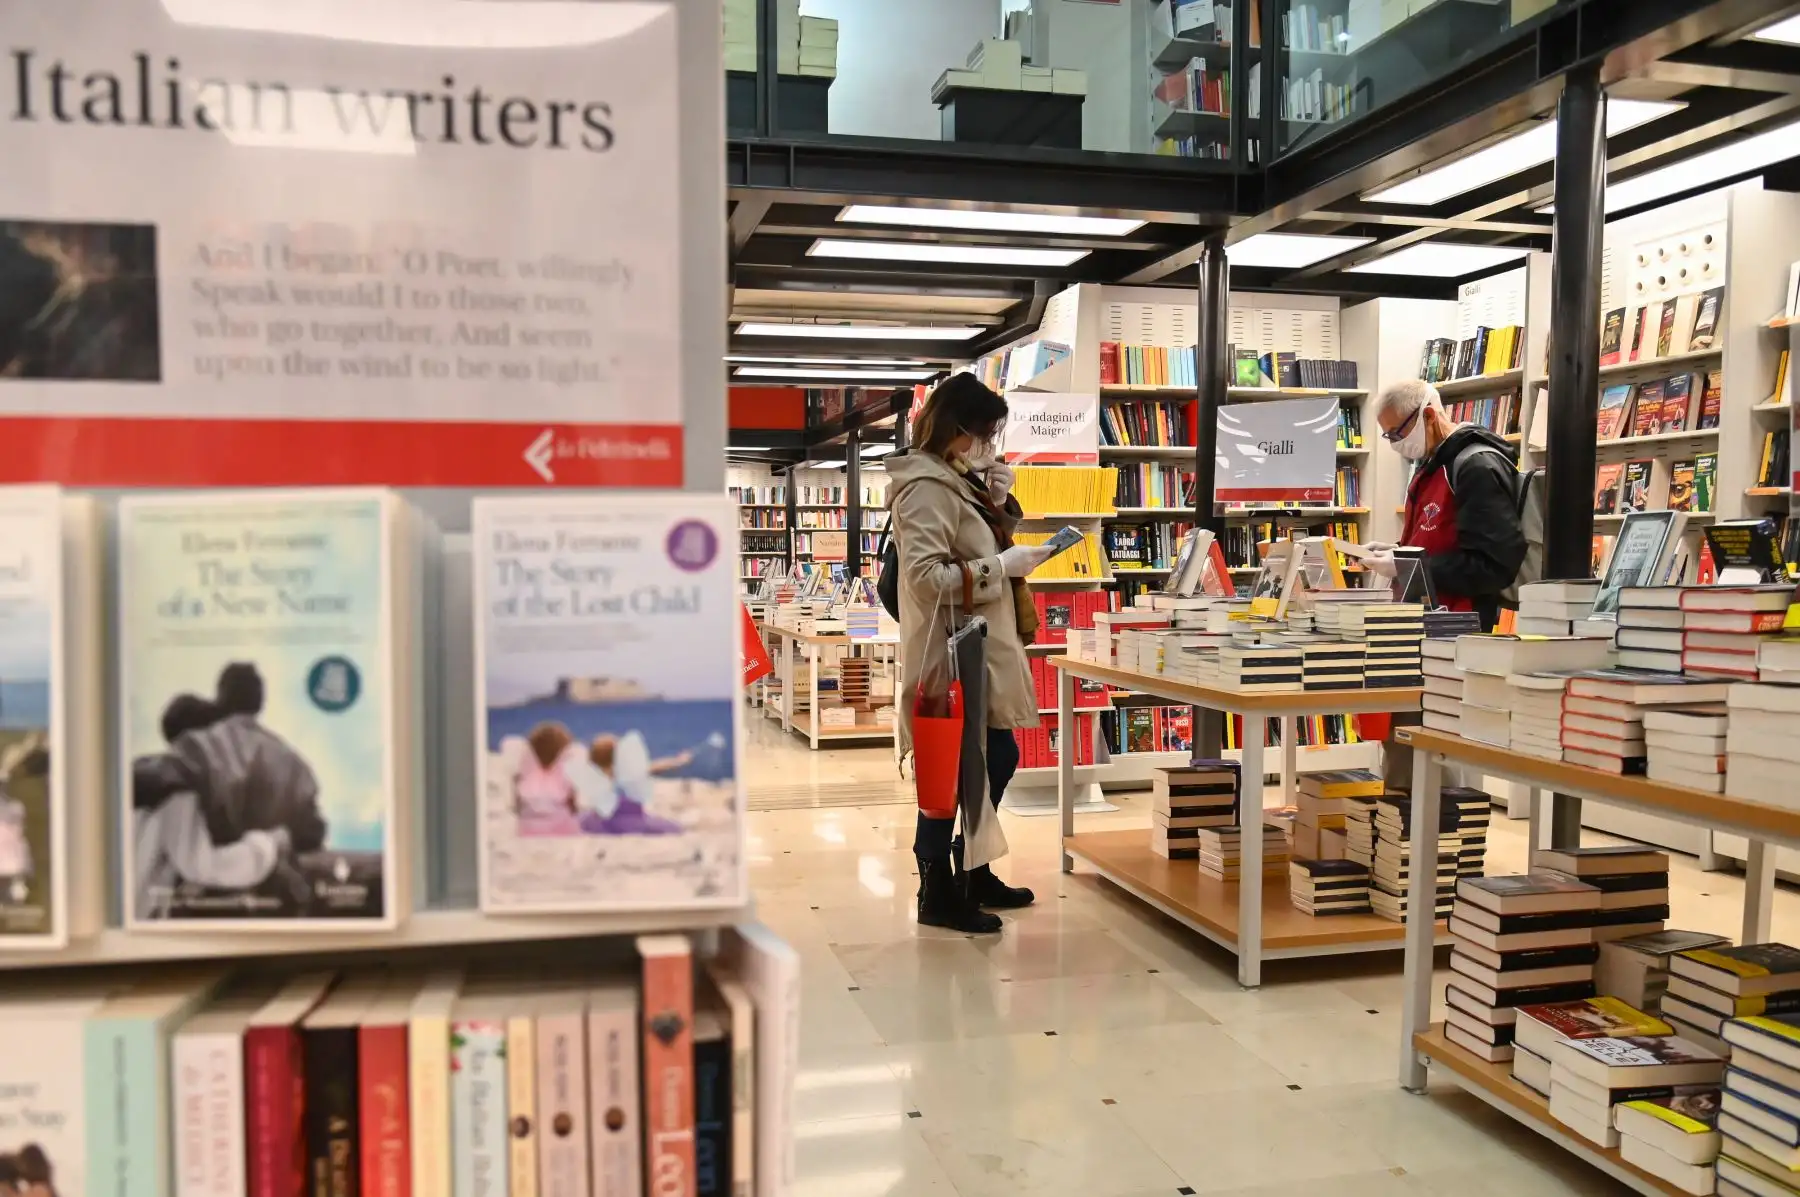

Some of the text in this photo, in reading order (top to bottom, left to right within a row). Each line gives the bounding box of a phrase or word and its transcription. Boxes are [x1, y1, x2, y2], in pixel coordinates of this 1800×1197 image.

[10, 48, 615, 153] Italian writers
[290, 280, 386, 310] would
[411, 288, 442, 311] to
[447, 286, 529, 313] those
[192, 314, 259, 338] who
[453, 320, 511, 347] And
[282, 350, 331, 377] the
[338, 353, 413, 378] wind
[420, 358, 450, 380] to
[456, 356, 493, 381] be
[1029, 411, 1073, 425] indagini
[1257, 440, 1294, 456] Gialli
[570, 588, 626, 616] Lost
[629, 584, 702, 616] Child
[741, 659, 760, 675] nelli
[652, 1130, 694, 1197] Leo
